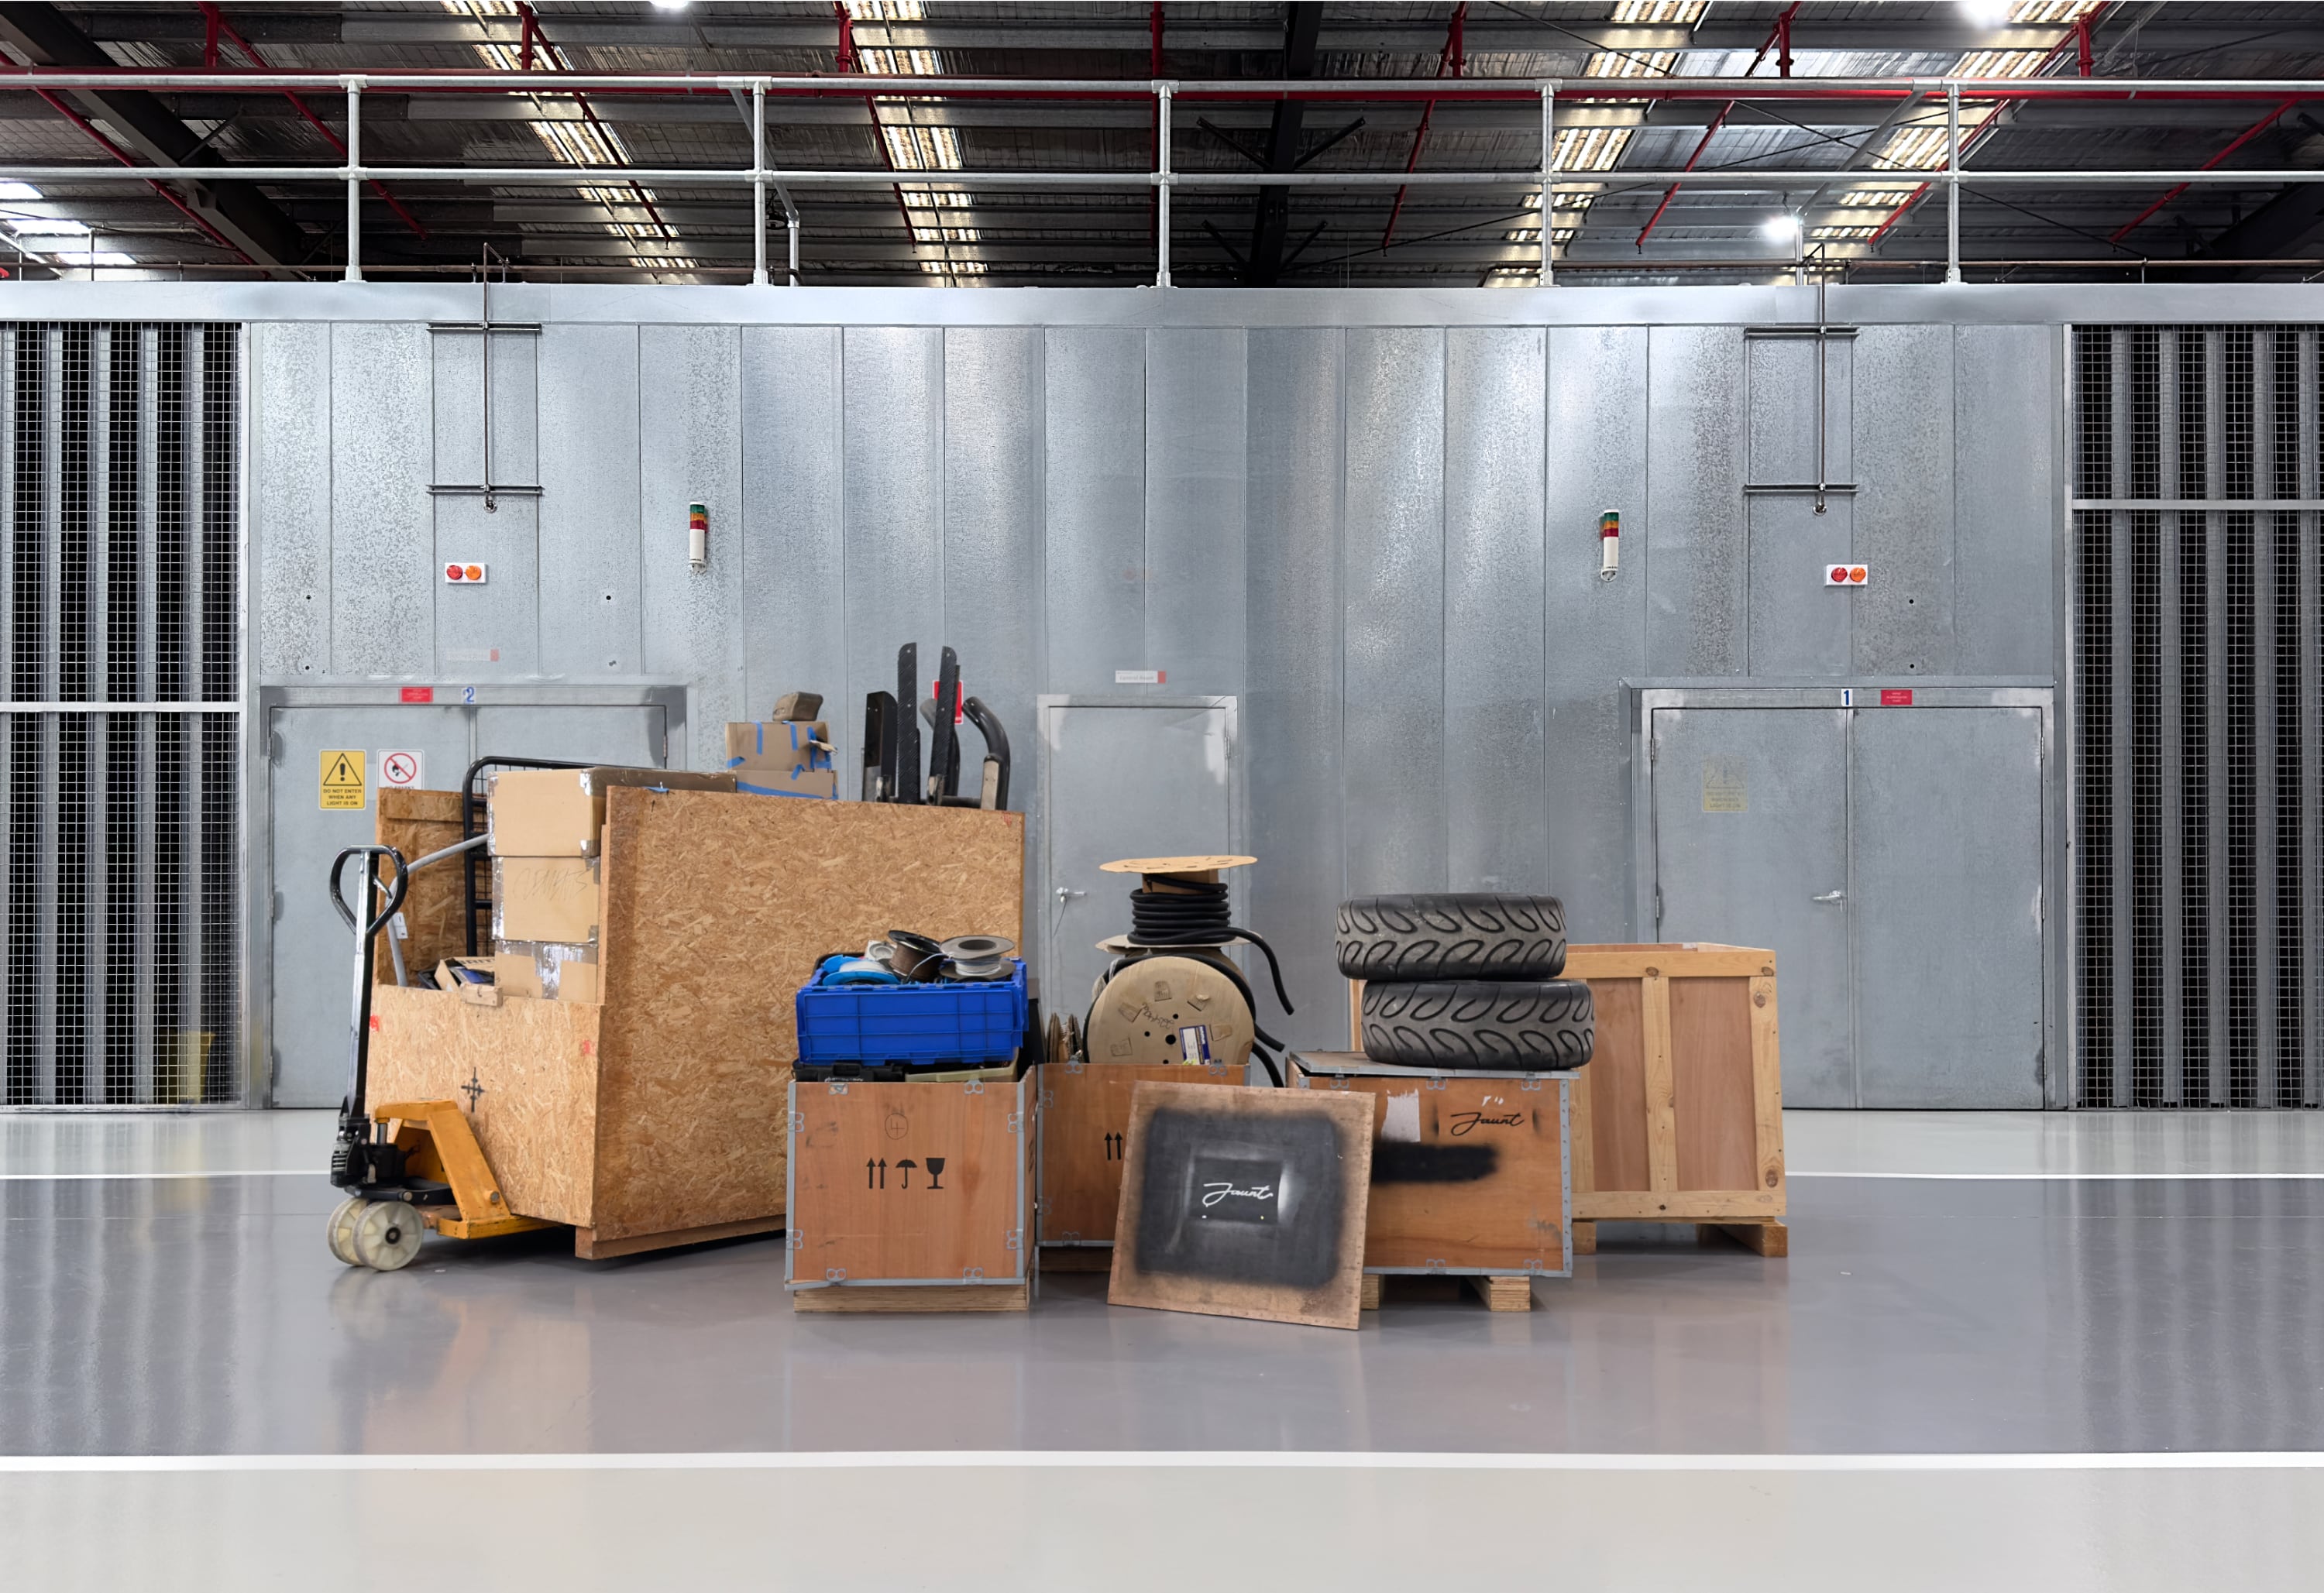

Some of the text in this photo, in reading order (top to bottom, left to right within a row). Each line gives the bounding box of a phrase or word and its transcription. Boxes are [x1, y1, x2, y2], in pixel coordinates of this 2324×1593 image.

[463, 686, 475, 702] 2
[1844, 689, 1850, 706] 1
[1450, 1112, 1525, 1136] Jaunt
[1202, 1183, 1274, 1207] Jaunt
